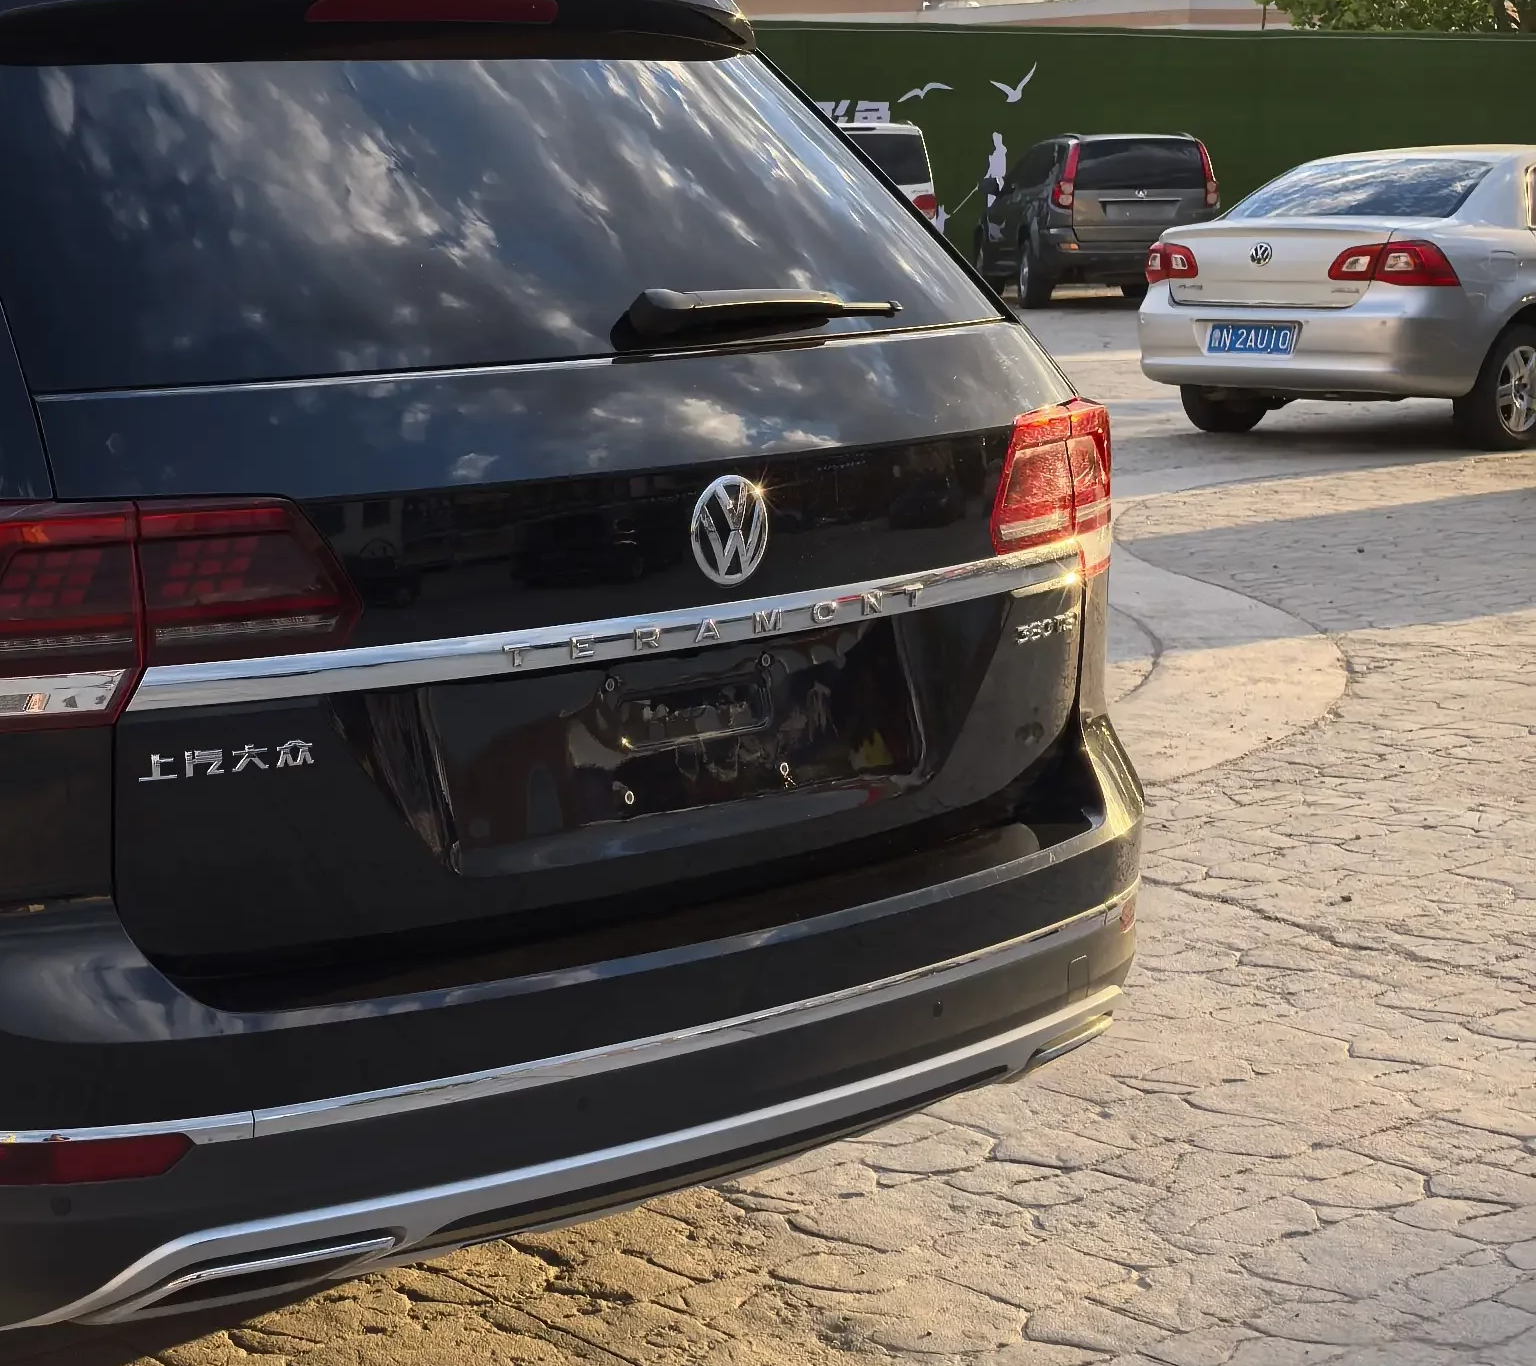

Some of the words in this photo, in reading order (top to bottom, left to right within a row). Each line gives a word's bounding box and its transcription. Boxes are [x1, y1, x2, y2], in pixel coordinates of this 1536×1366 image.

[503, 583, 924, 667] TERAMONT
[138, 739, 315, 783] 上汽大众
